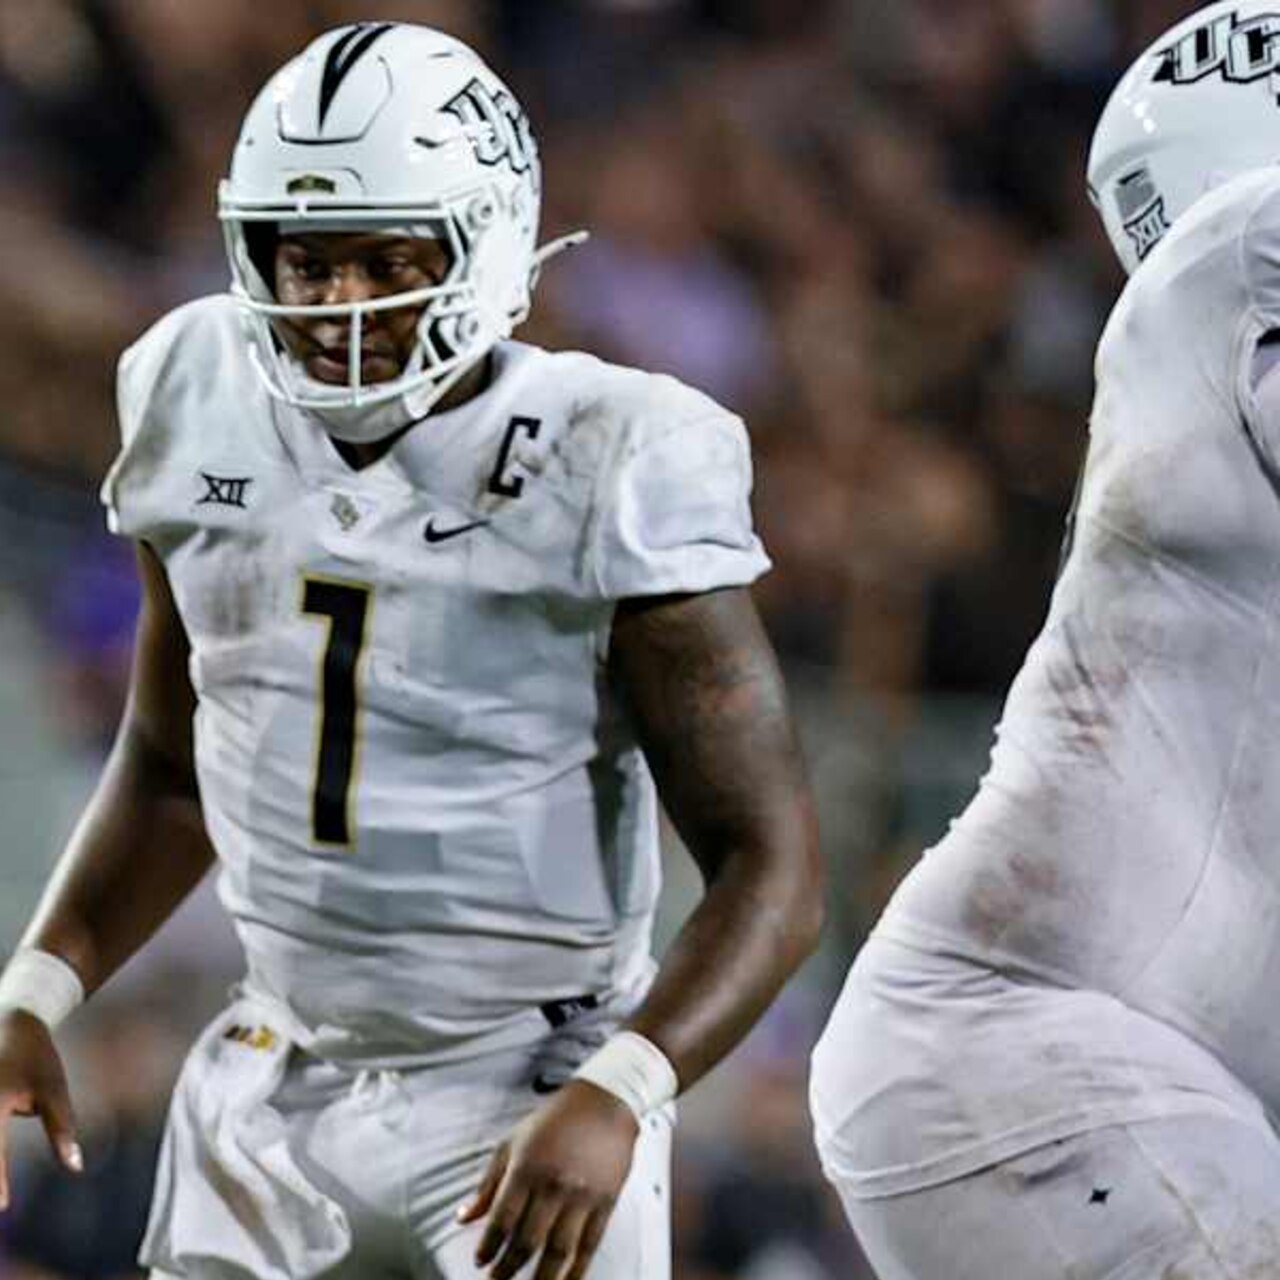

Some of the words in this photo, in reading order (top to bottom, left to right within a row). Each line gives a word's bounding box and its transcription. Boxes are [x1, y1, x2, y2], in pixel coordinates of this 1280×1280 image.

[1151, 10, 1280, 106] UC
[195, 472, 254, 509] XII
[489, 416, 542, 498] C
[300, 573, 374, 853] 1
